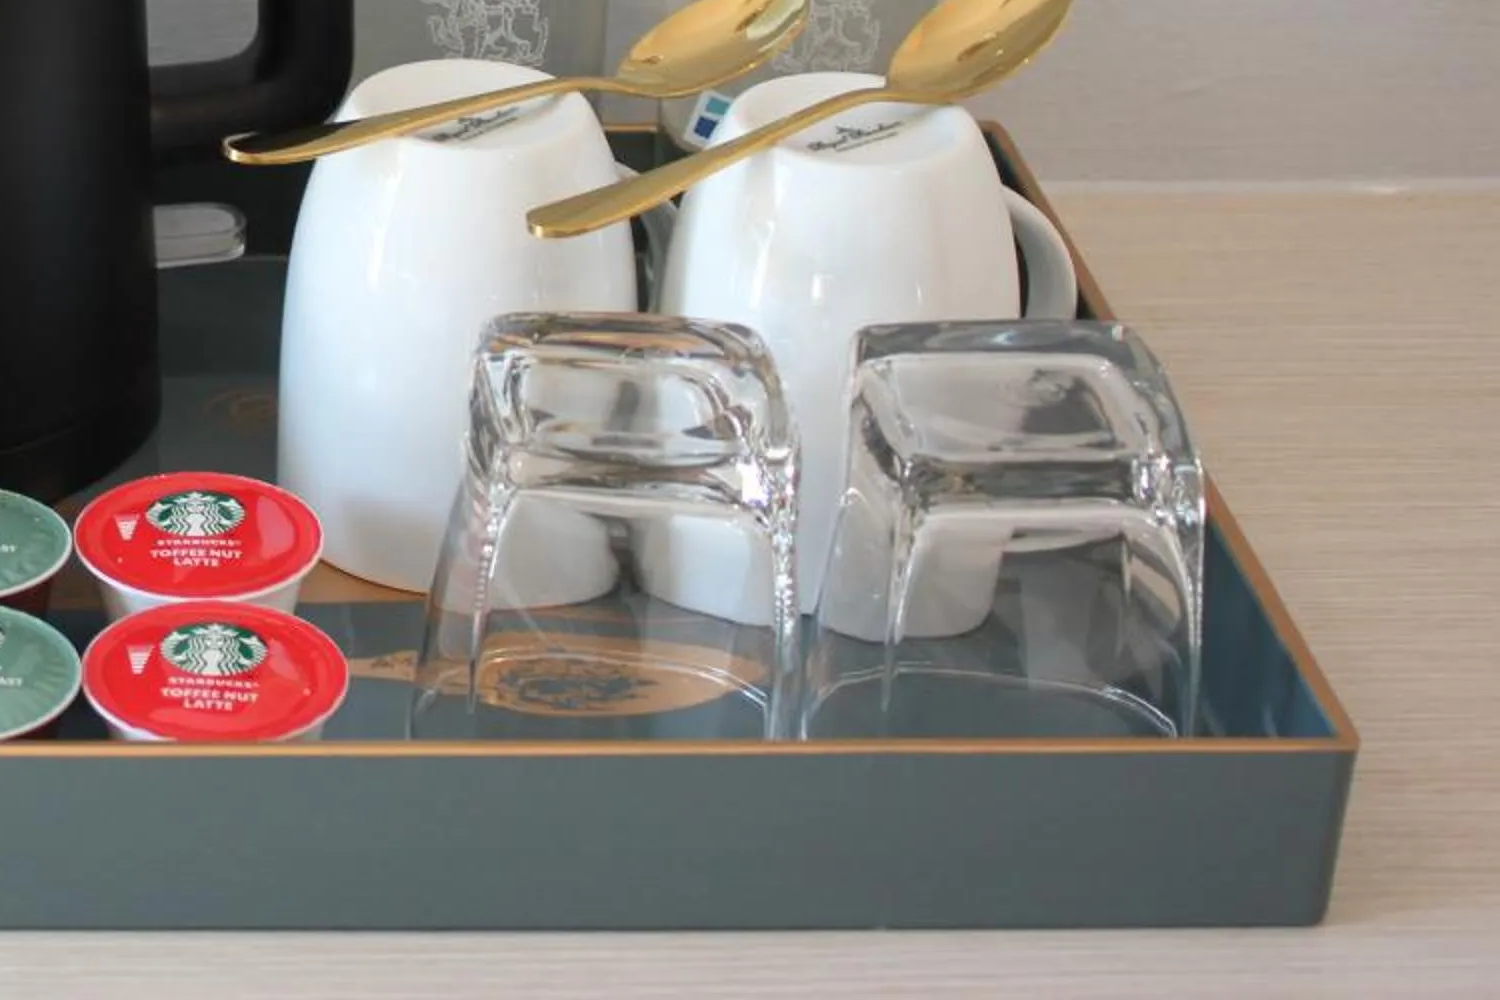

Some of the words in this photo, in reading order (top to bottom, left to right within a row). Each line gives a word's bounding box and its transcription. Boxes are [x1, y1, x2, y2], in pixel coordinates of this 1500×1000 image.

[150, 548, 206, 558] TOFFEE
[209, 548, 242, 559] NUT
[173, 557, 219, 567] LATTE
[160, 687, 220, 699] TOFFEE
[223, 690, 258, 703] NUT
[183, 698, 234, 711] LATTE
